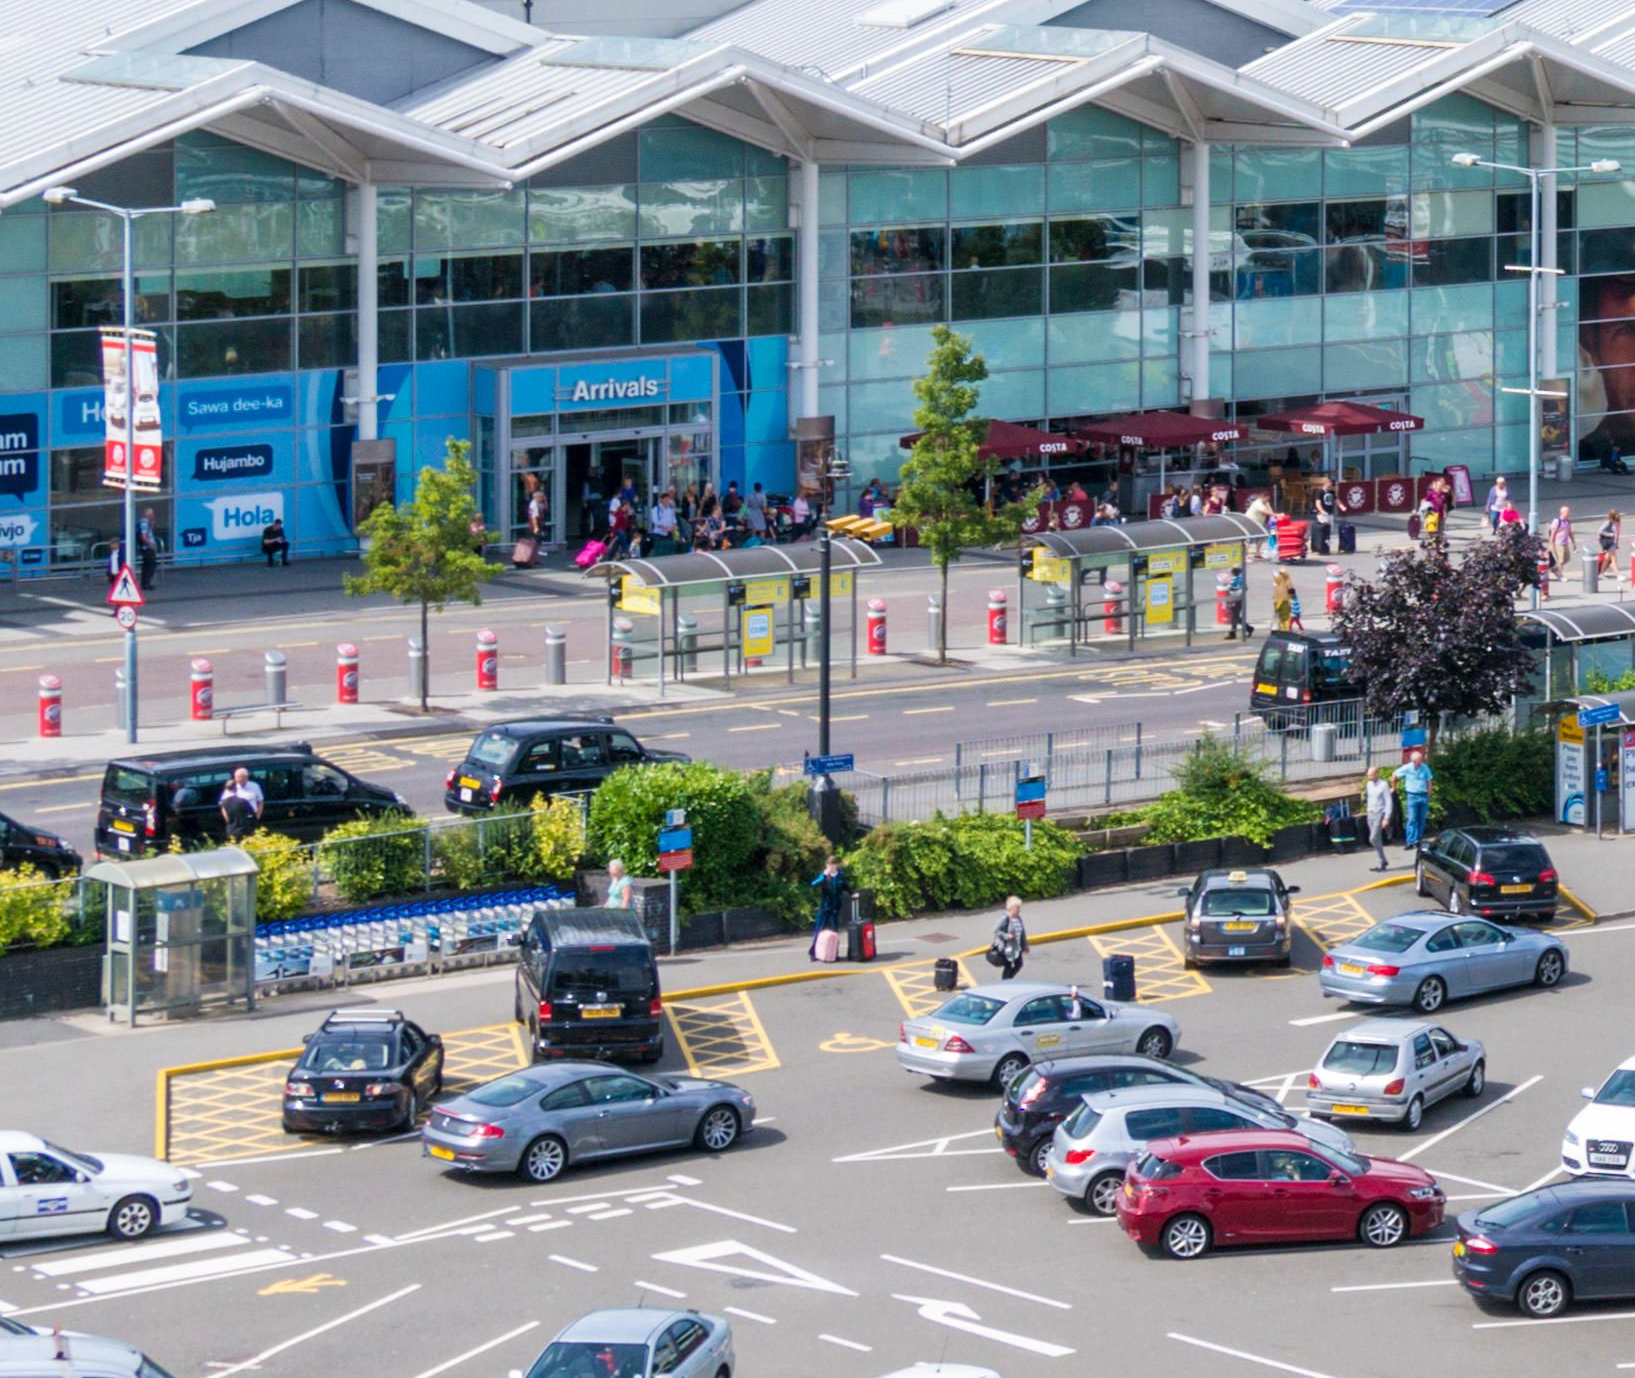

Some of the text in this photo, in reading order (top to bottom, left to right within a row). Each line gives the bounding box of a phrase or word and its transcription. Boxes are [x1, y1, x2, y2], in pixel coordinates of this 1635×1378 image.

[573, 376, 658, 401] Arrivals
[188, 395, 283, 415] Sawa dee-ka
[1302, 423, 1325, 434] COSTA
[1389, 420, 1415, 431] COSTA
[1121, 435, 1143, 446] COSTA
[1212, 429, 1240, 441] COSTA
[1040, 443, 1067, 453] COSTA
[203, 454, 265, 472] Hujambo
[224, 505, 275, 528] Hola
